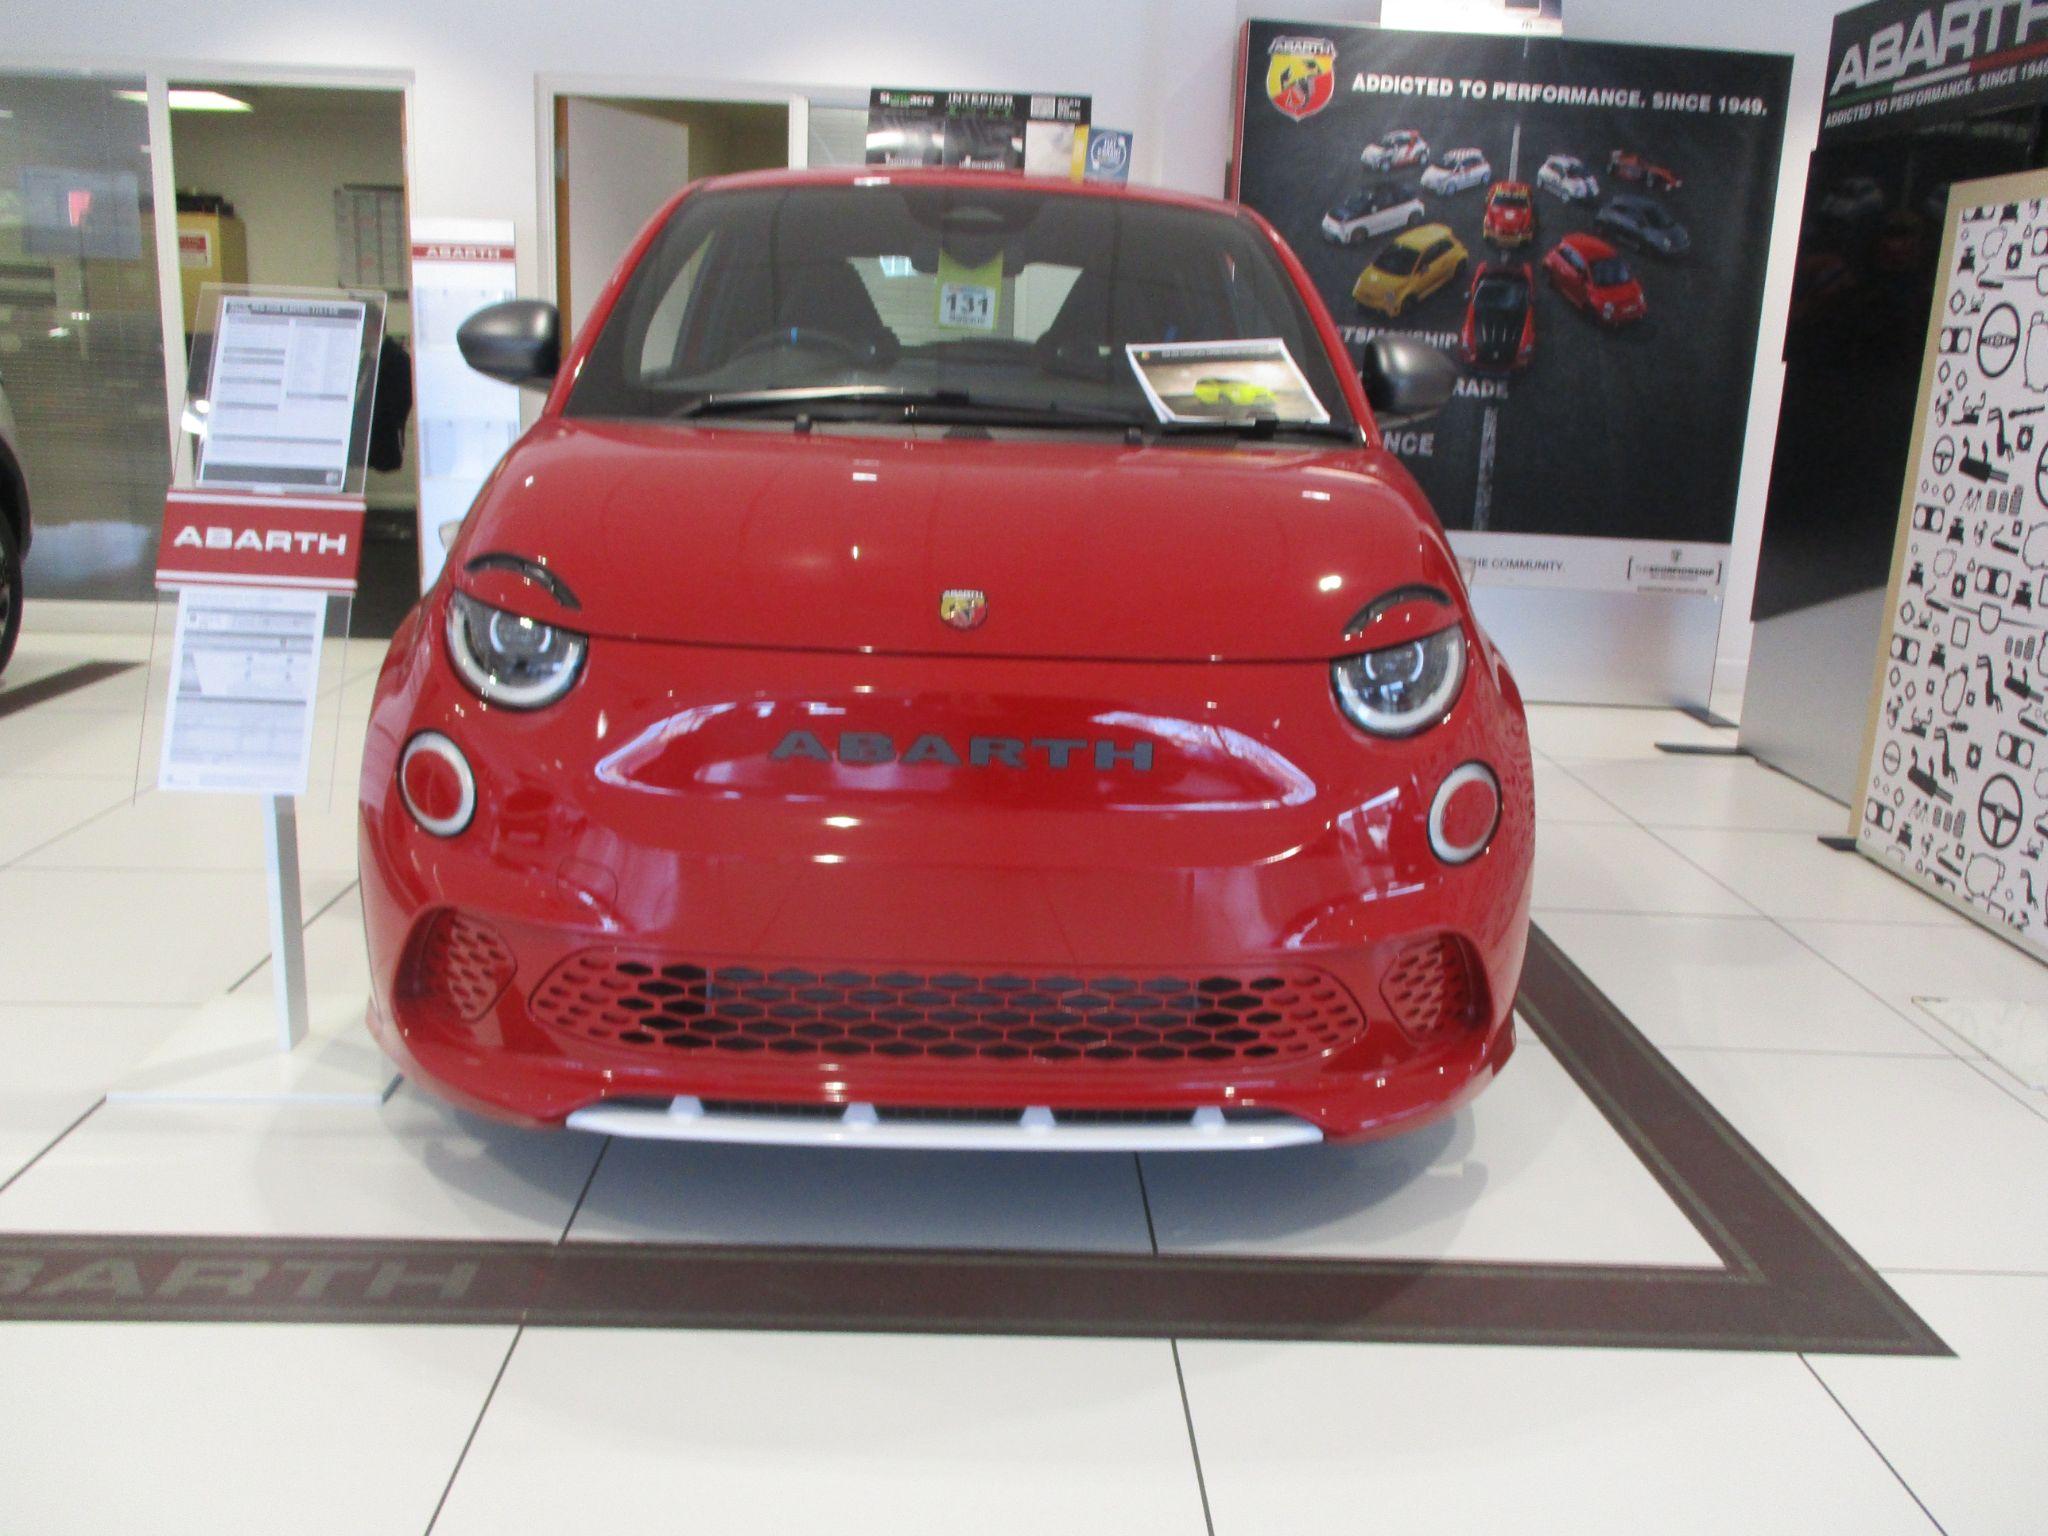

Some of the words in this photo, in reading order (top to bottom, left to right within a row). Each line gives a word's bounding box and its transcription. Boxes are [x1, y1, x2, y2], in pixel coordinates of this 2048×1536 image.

[1829, 0, 2048, 96] ABARTH
[1351, 72, 1453, 98] ADDICTED
[1459, 79, 1487, 100] TO
[1492, 81, 1646, 109] PERFORMANCE.
[1652, 91, 1712, 113] SINCE
[1825, 103, 1872, 129] ADDICTED
[1874, 100, 1887, 115] TO
[1979, 65, 2017, 92] SINCE
[426, 246, 500, 260] ABARTH
[173, 525, 347, 556] ABARTH
[768, 729, 1154, 772] ABARTH
